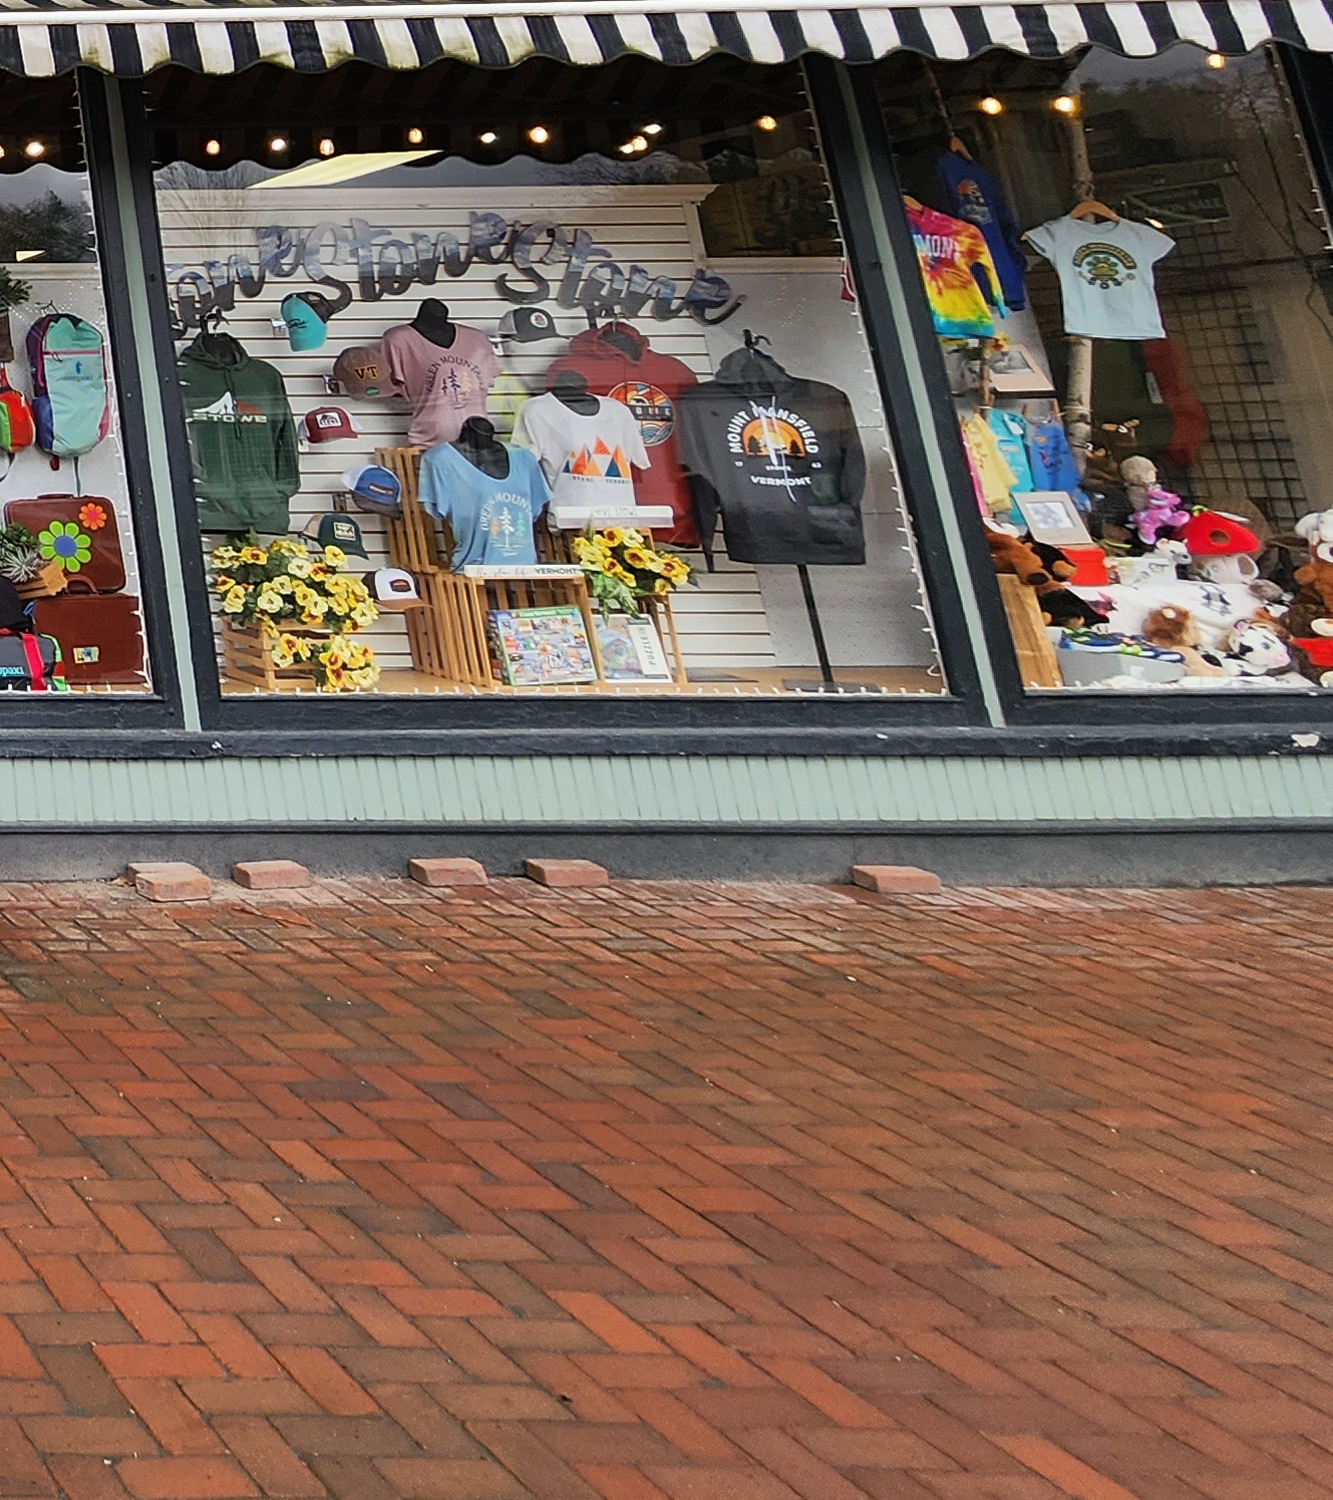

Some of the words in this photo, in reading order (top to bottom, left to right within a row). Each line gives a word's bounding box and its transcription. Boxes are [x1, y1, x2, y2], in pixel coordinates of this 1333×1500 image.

[354, 365, 377, 379] VT
[726, 411, 751, 453] MOUNT
[752, 405, 820, 454] MANSFIELD
[750, 475, 812, 486] VERMONT
